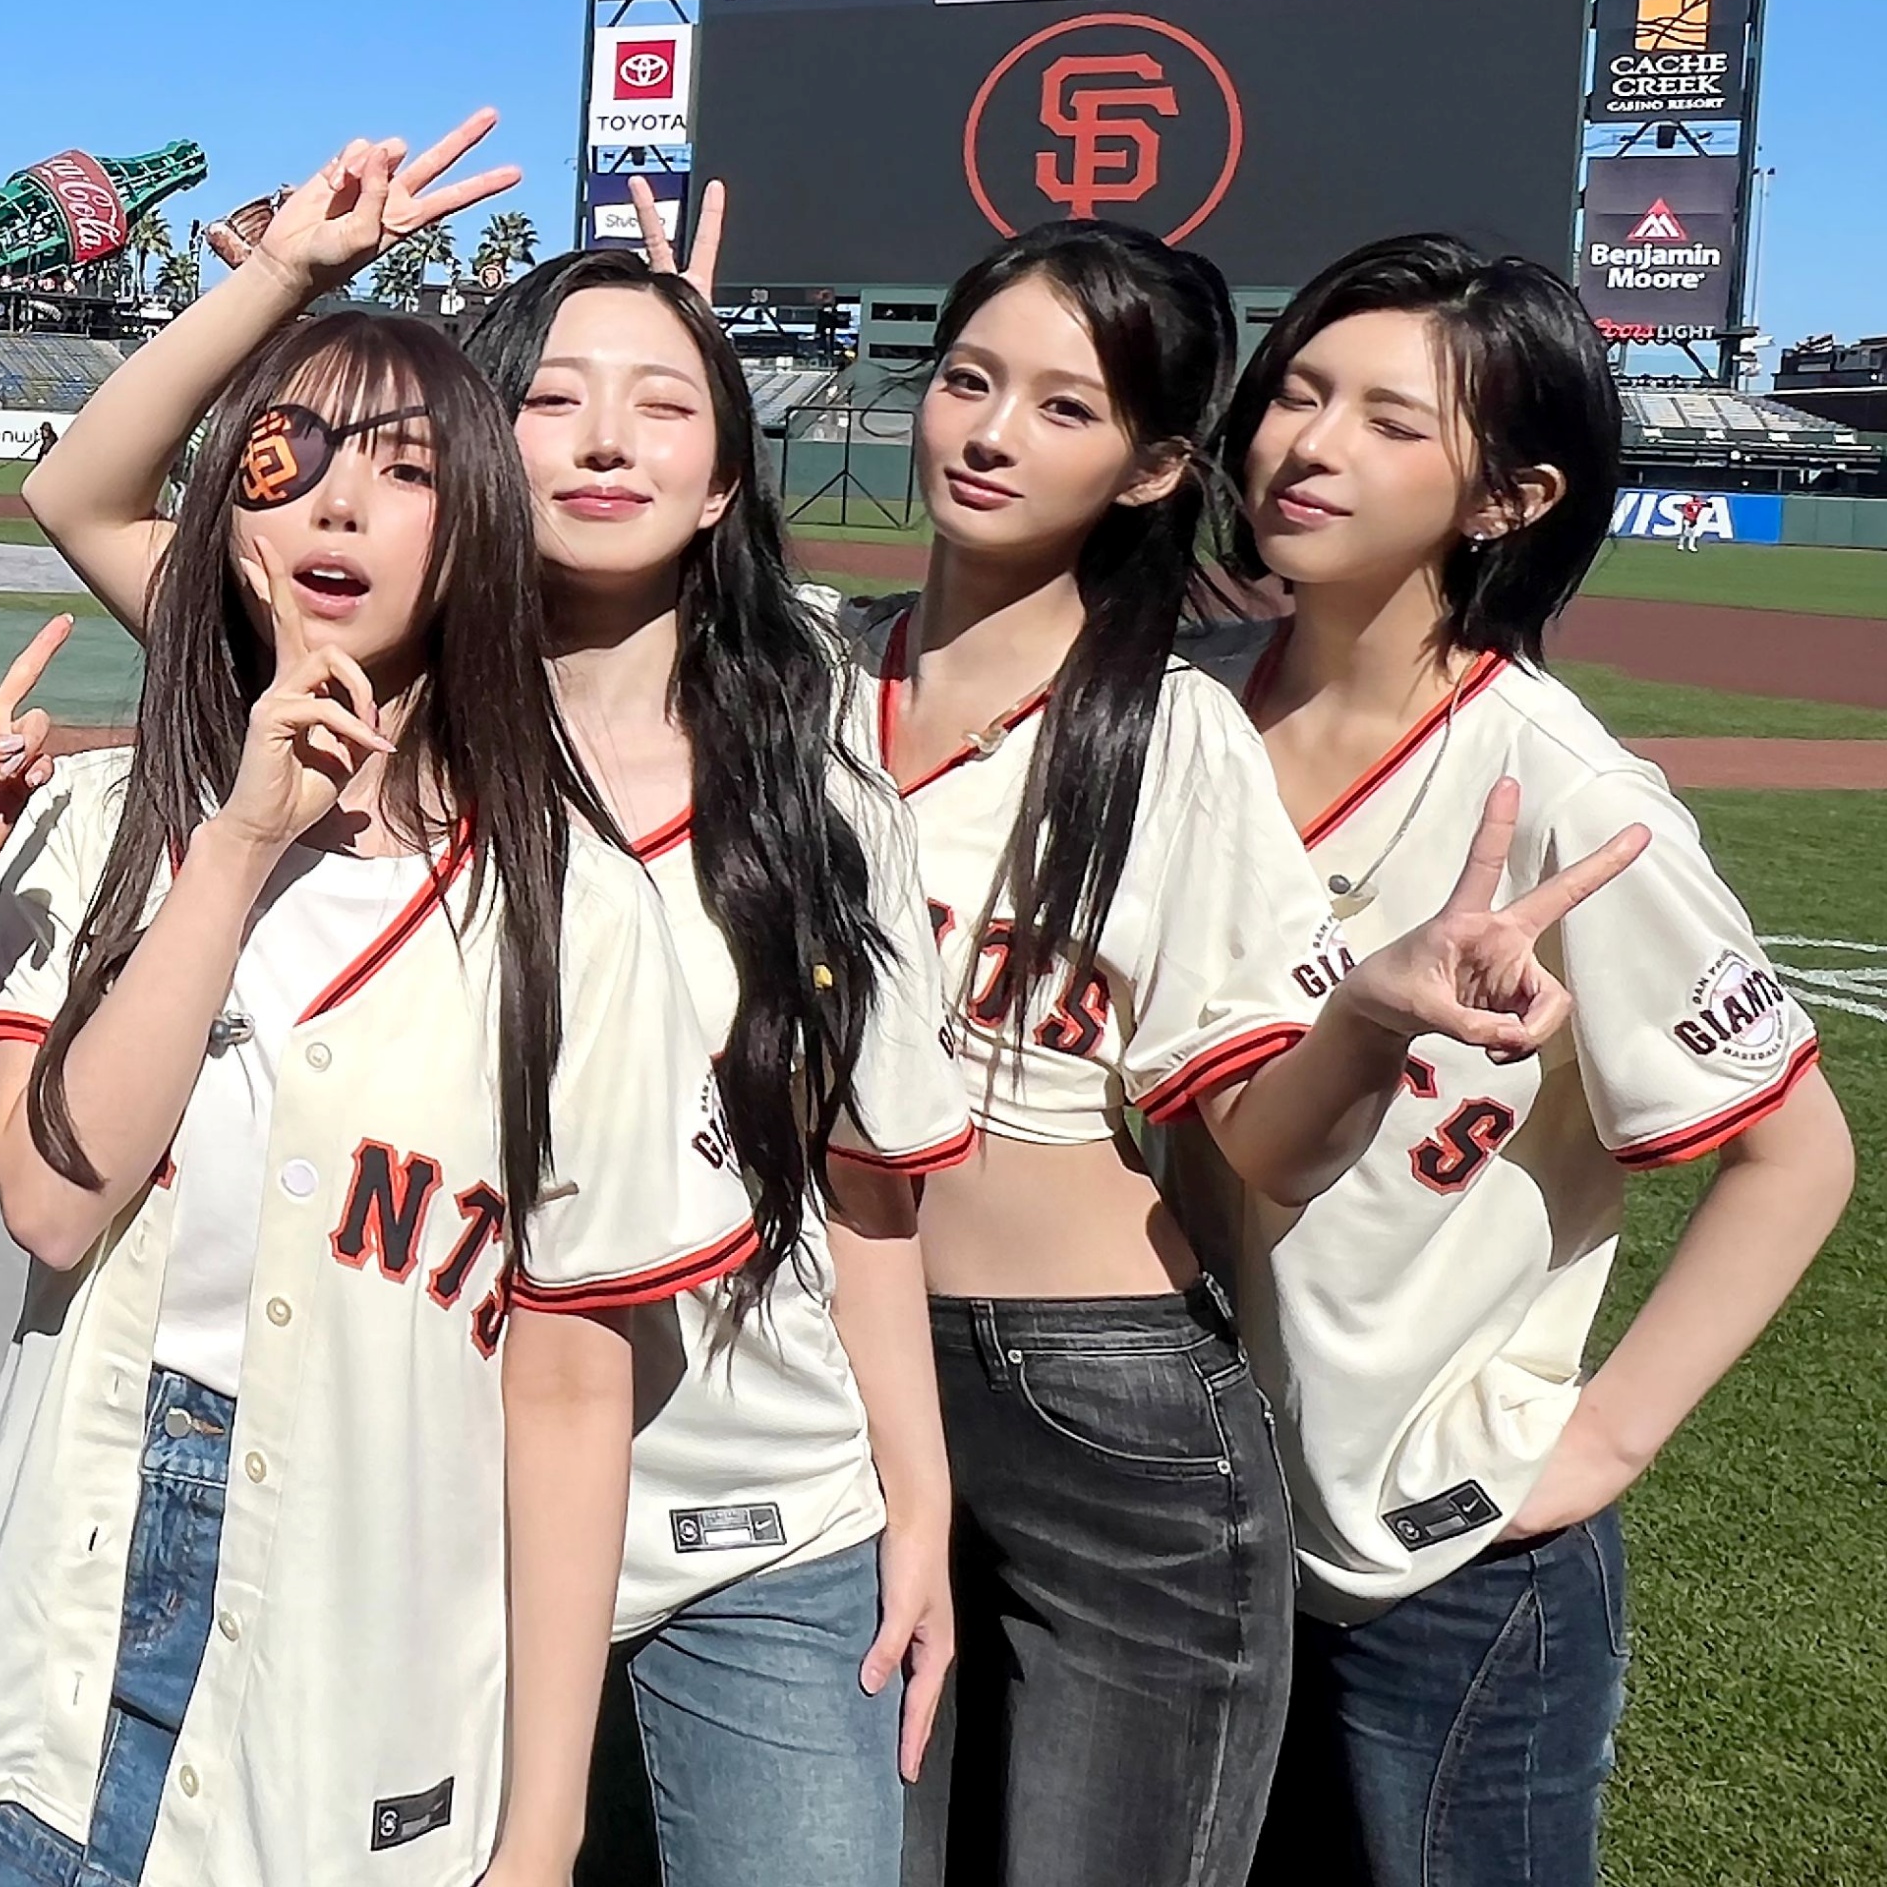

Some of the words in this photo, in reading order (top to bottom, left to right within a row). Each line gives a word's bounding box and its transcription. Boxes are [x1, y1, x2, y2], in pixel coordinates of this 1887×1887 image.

[1610, 53, 1728, 76] CACHE
[1612, 74, 1722, 97] CREEK
[1606, 98, 1664, 112] CASINO
[1667, 97, 1725, 111] RESORT
[597, 114, 686, 131] TOYOTA
[1590, 242, 1721, 269] Benjamin
[1606, 268, 1699, 291] Moore
[1657, 324, 1716, 339] LIGHT
[1674, 968, 1784, 1056] GIANTS
